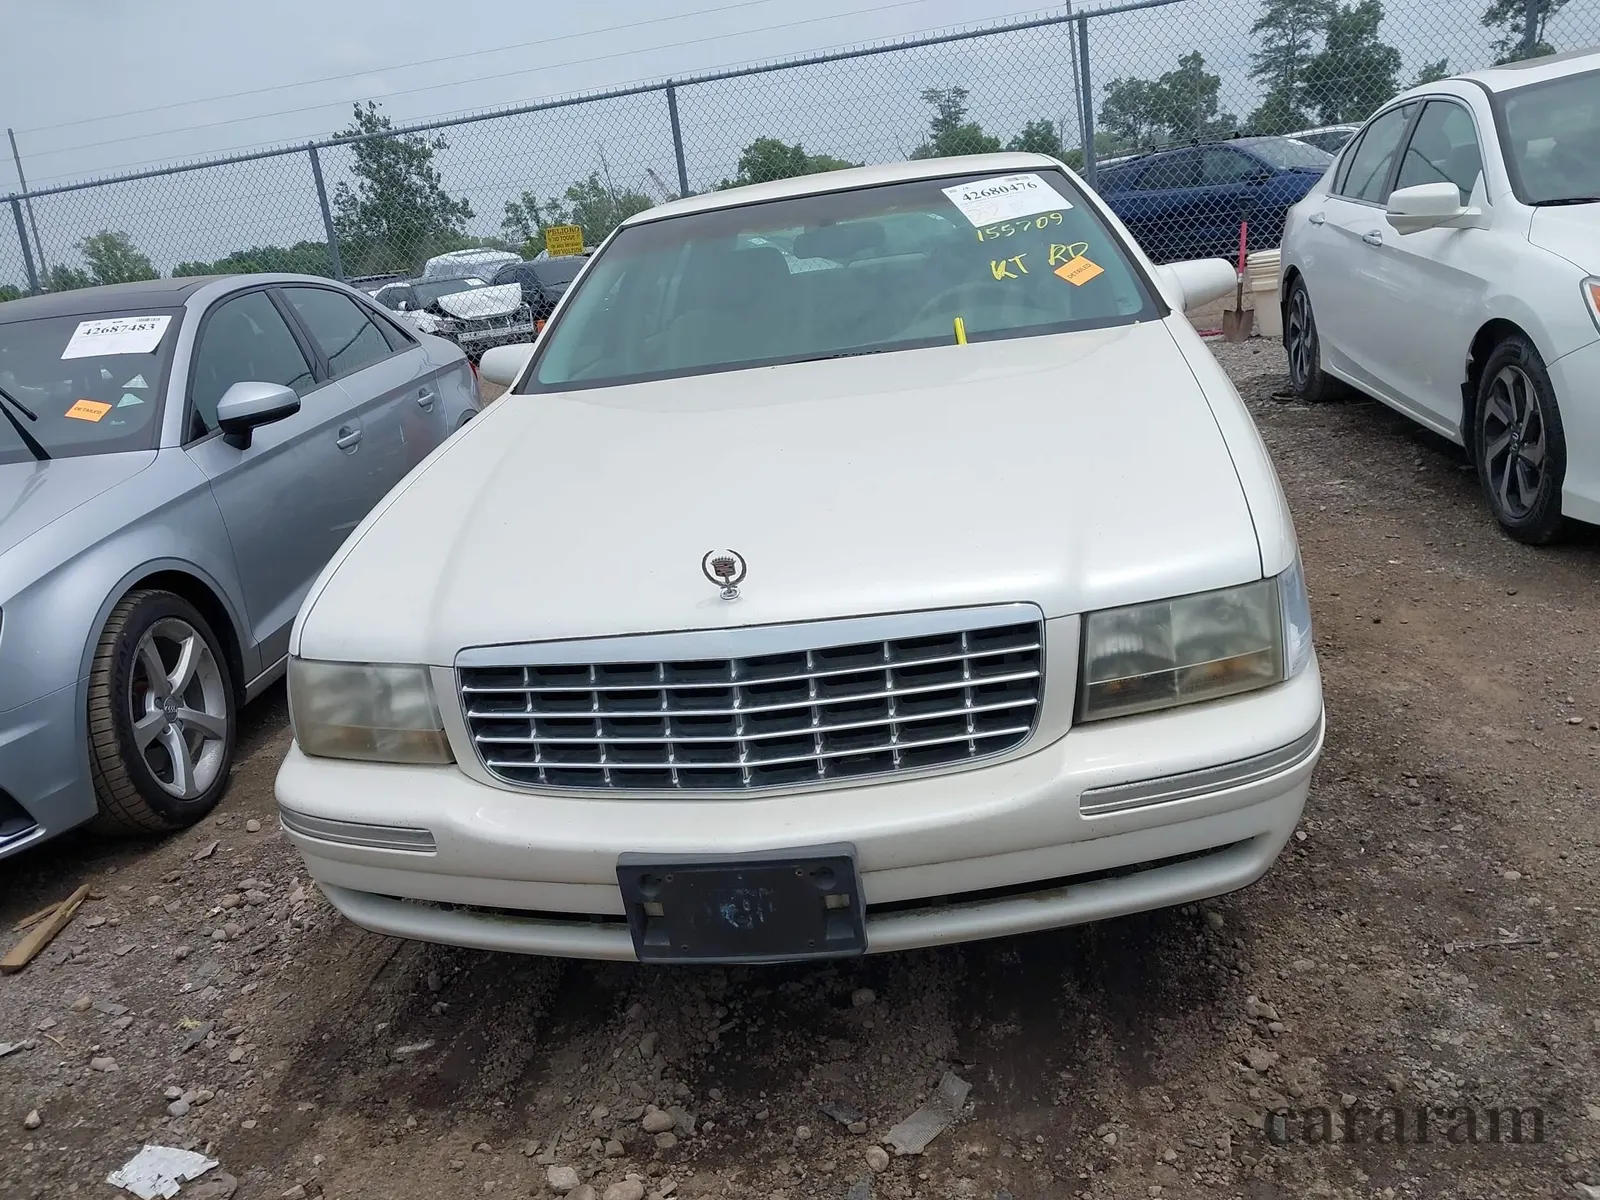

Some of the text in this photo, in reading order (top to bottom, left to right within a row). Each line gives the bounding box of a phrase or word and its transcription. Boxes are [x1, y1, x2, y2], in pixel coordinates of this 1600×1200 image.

[962, 181, 1038, 202] 42680476
[547, 226, 580, 234] PELIGRO
[977, 212, 1063, 242] 155709
[1067, 263, 1092, 279] DETAILED
[82, 323, 155, 336] 42687483
[74, 406, 103, 415] DETAILED
